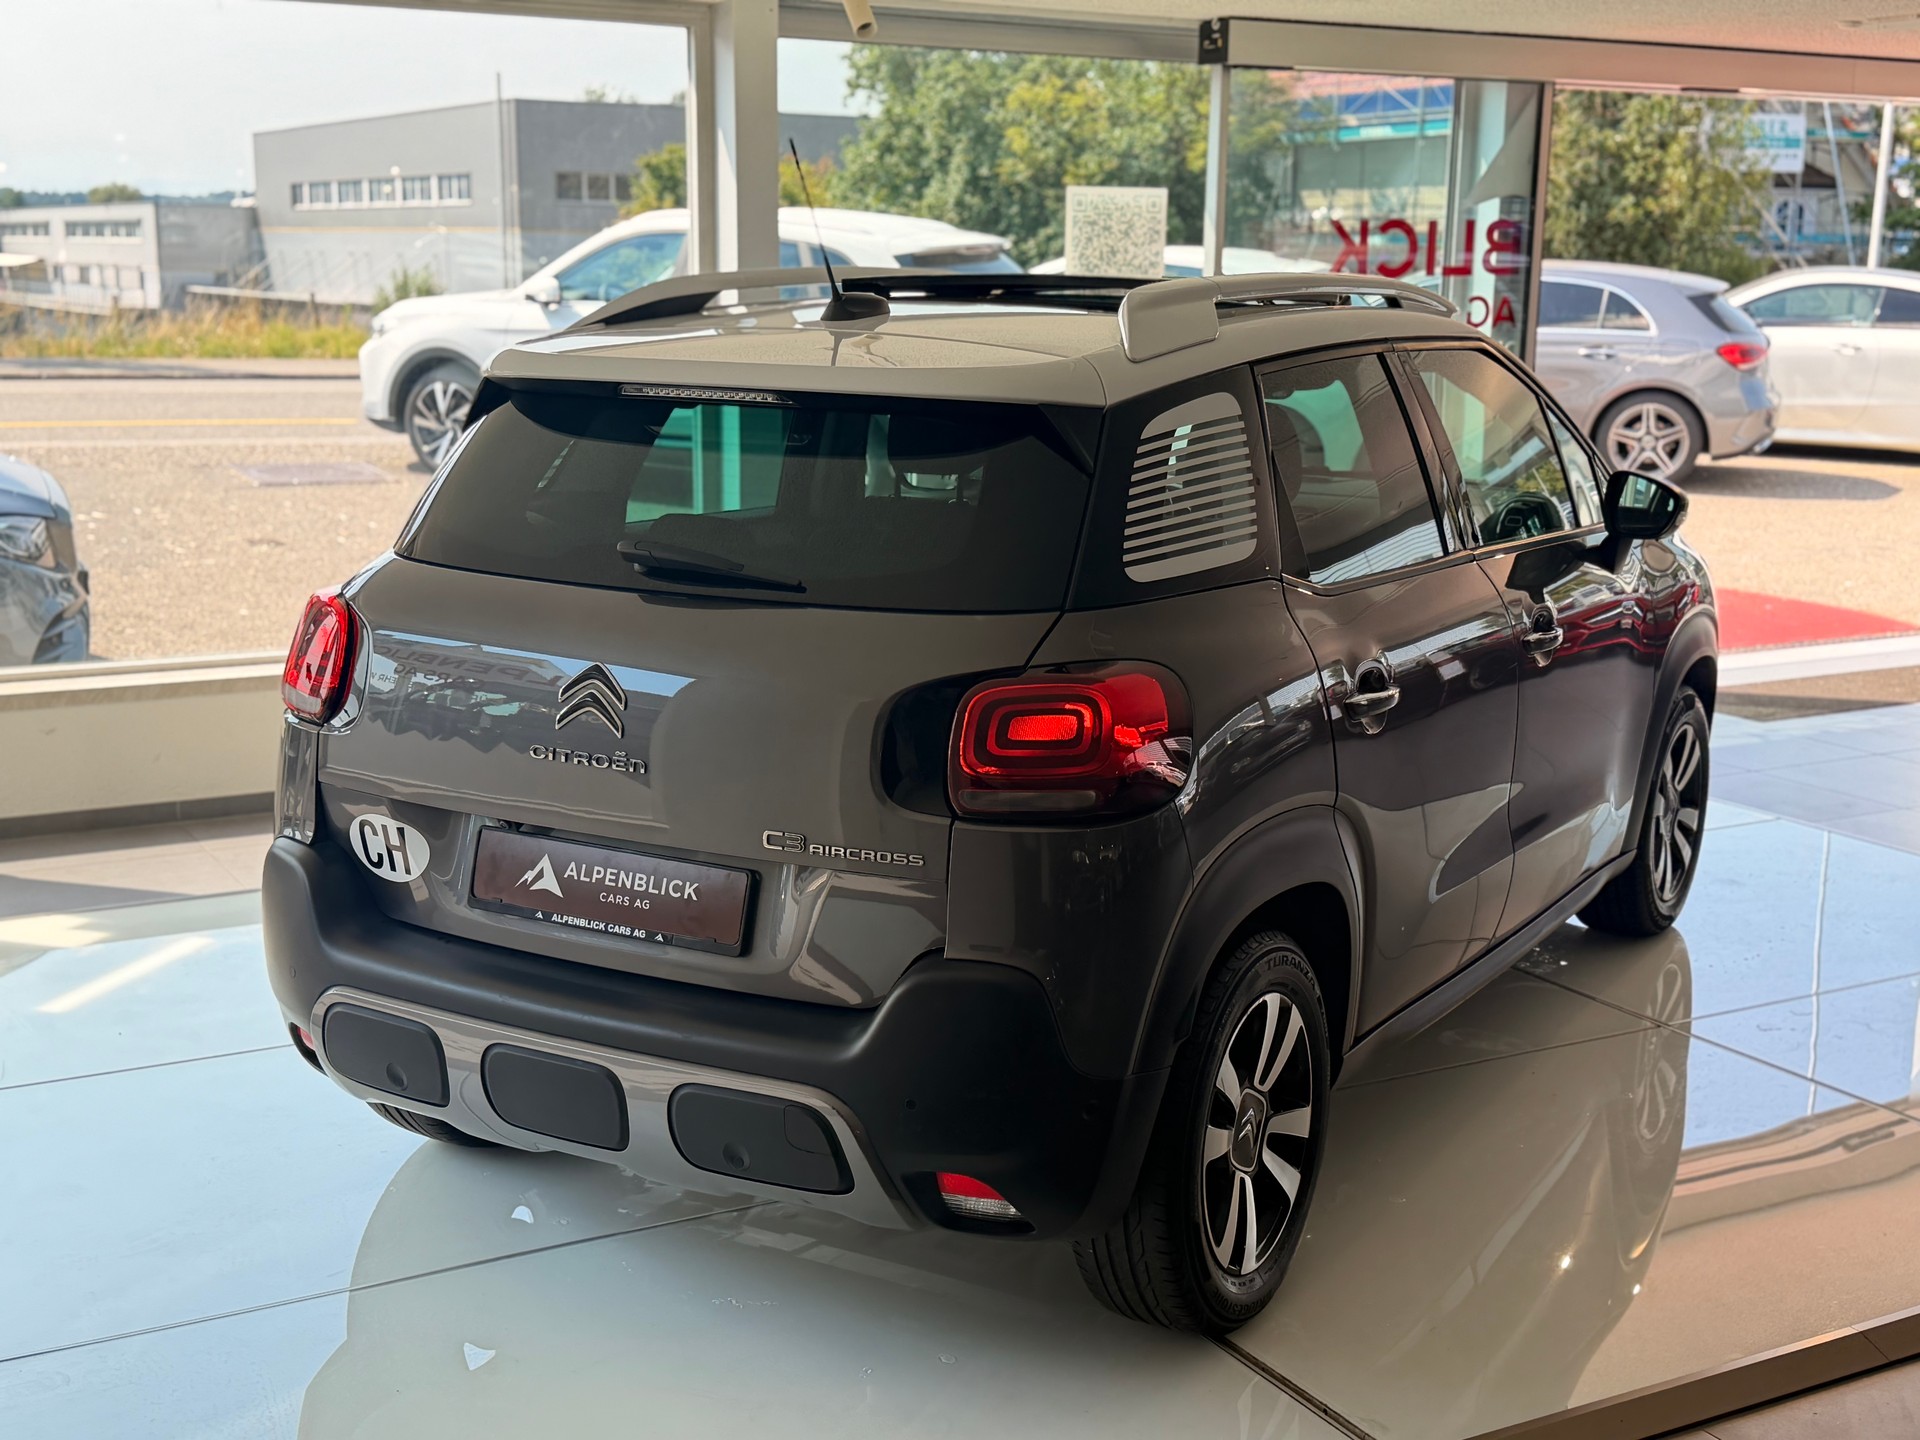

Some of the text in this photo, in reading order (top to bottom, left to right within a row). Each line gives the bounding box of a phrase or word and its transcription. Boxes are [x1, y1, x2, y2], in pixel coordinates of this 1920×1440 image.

[359, 819, 412, 876] CH
[762, 830, 925, 867] C3 AIRCROSS
[563, 861, 700, 901] ALPENBLICK
[599, 892, 651, 910] CARS AG
[551, 913, 647, 939] ALPENBLICK CARS AG
[1264, 955, 1316, 991] TURANZA
